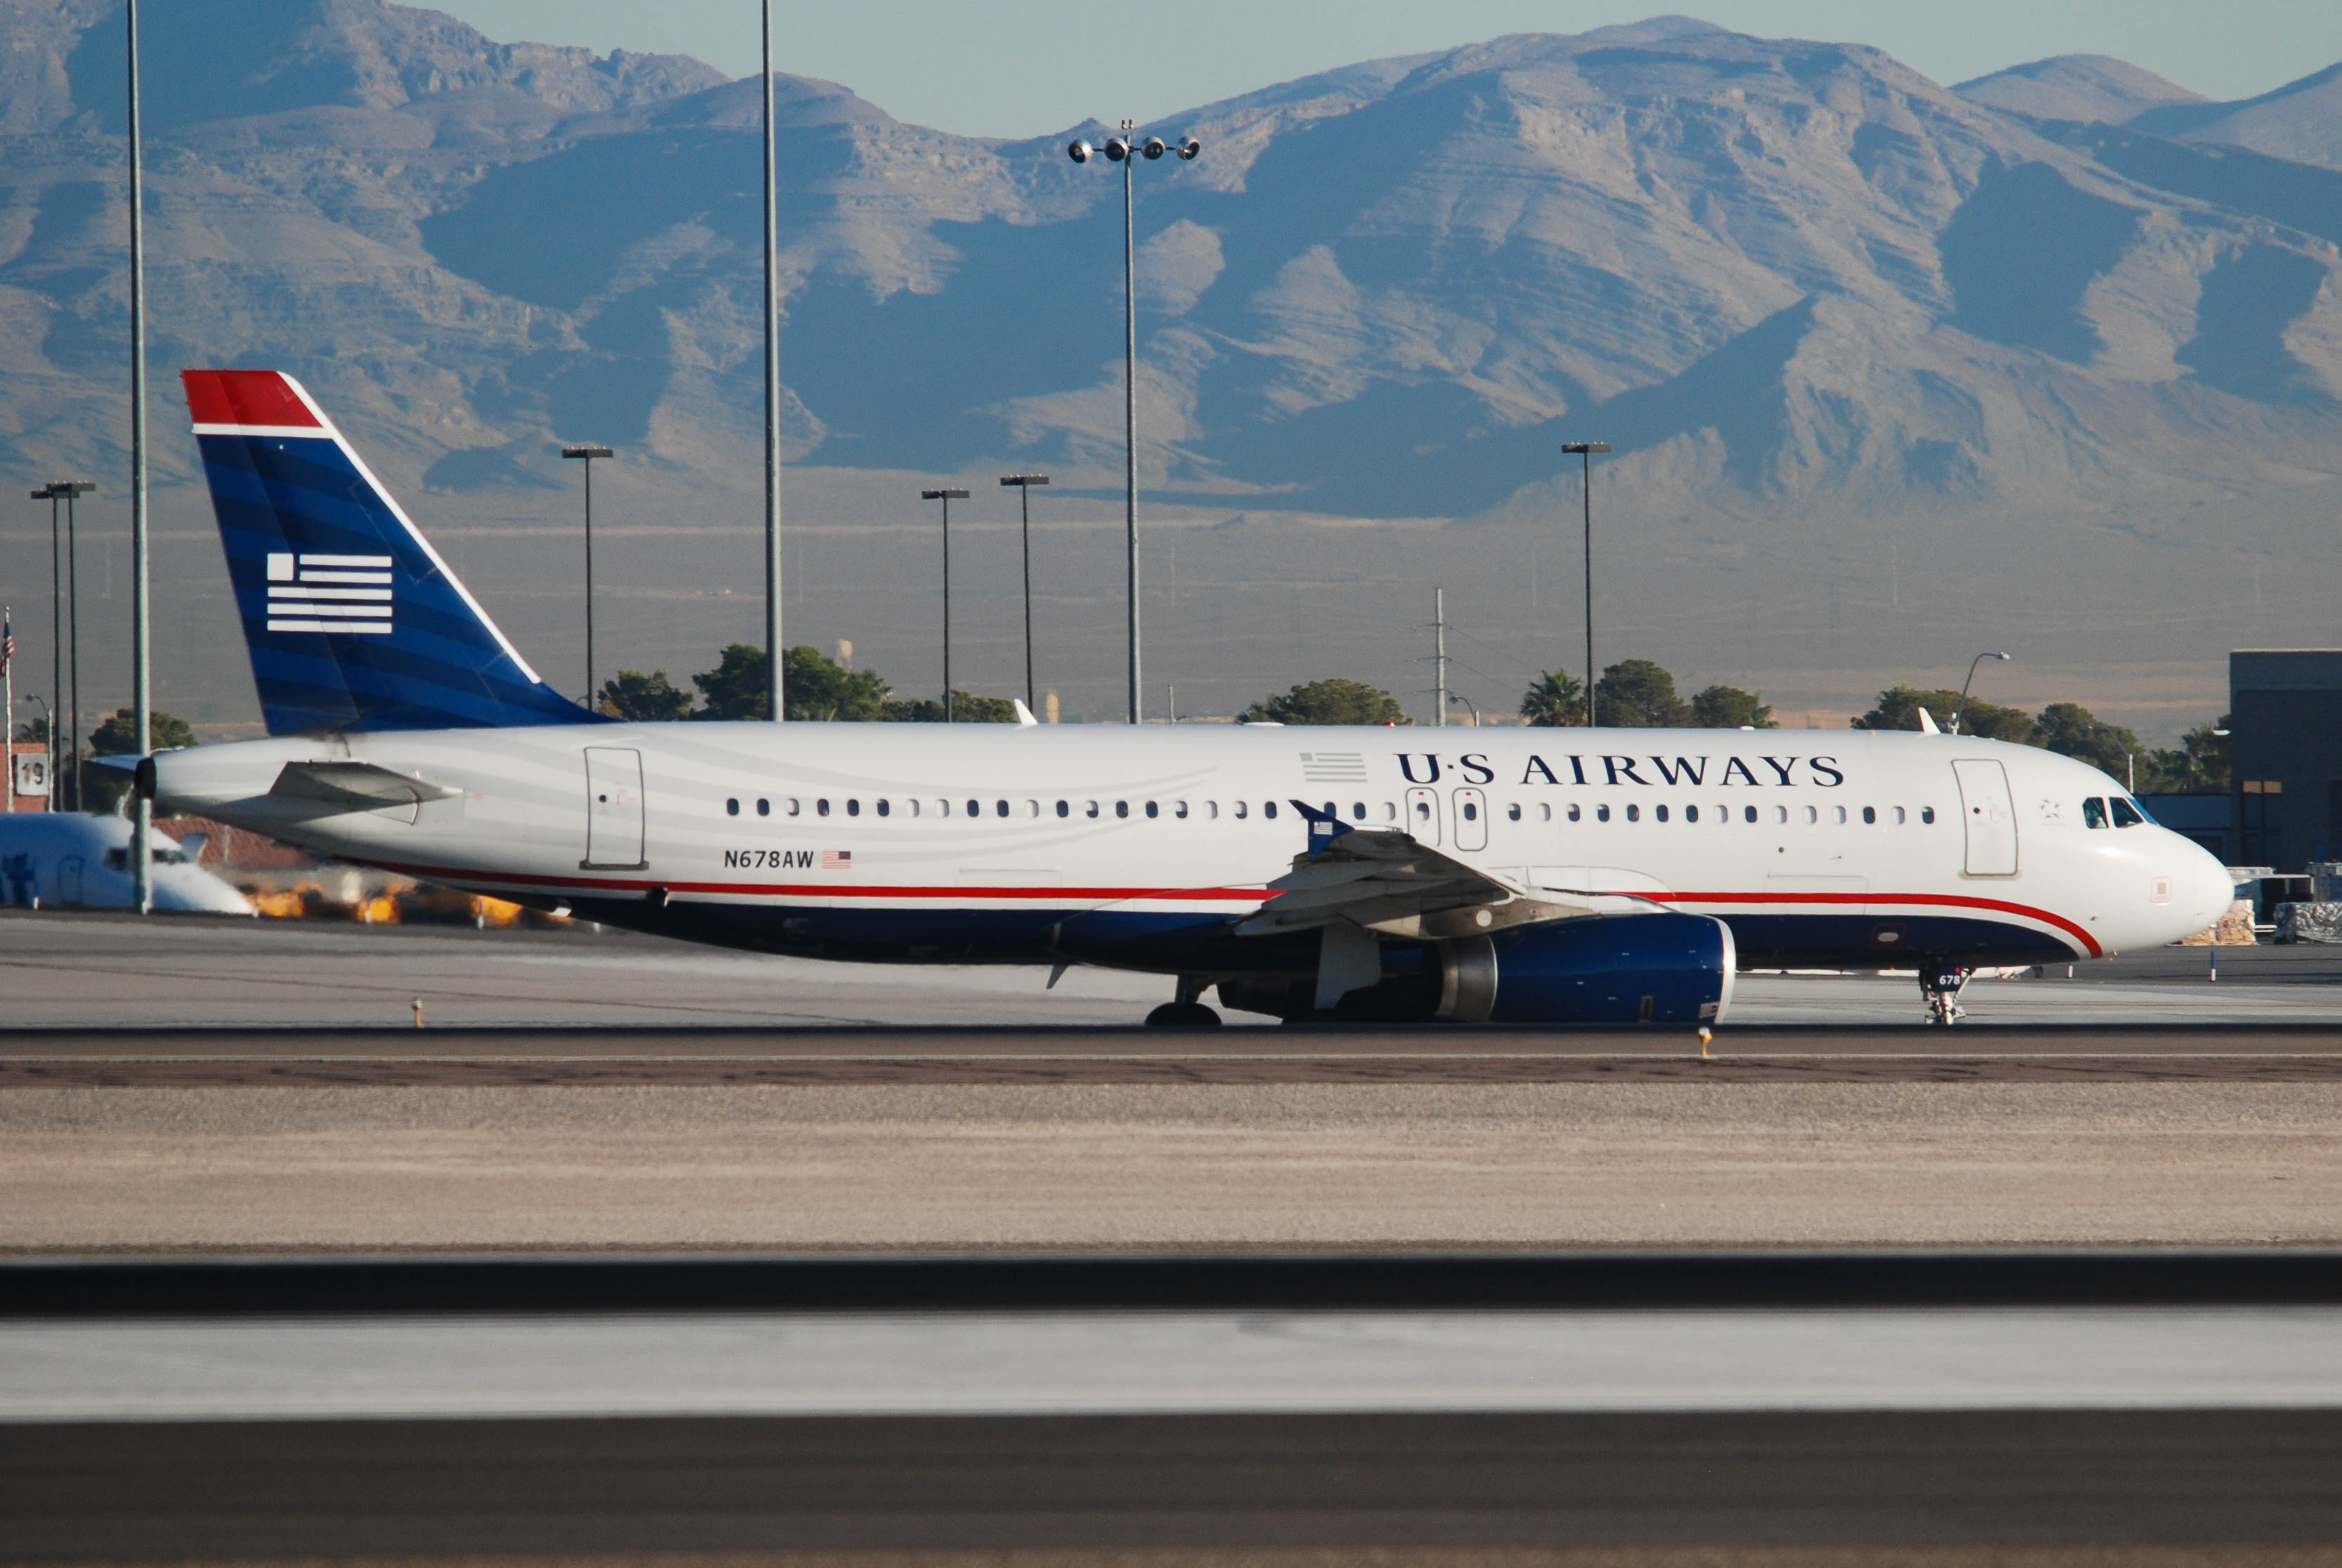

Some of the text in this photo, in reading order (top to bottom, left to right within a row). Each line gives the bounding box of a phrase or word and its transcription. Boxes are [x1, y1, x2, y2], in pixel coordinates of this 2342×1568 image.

[22, 763, 44, 785] 19
[1518, 755, 1844, 785] AIRWAYS
[725, 850, 814, 868] N678AW
[1939, 975, 1960, 985] 678
